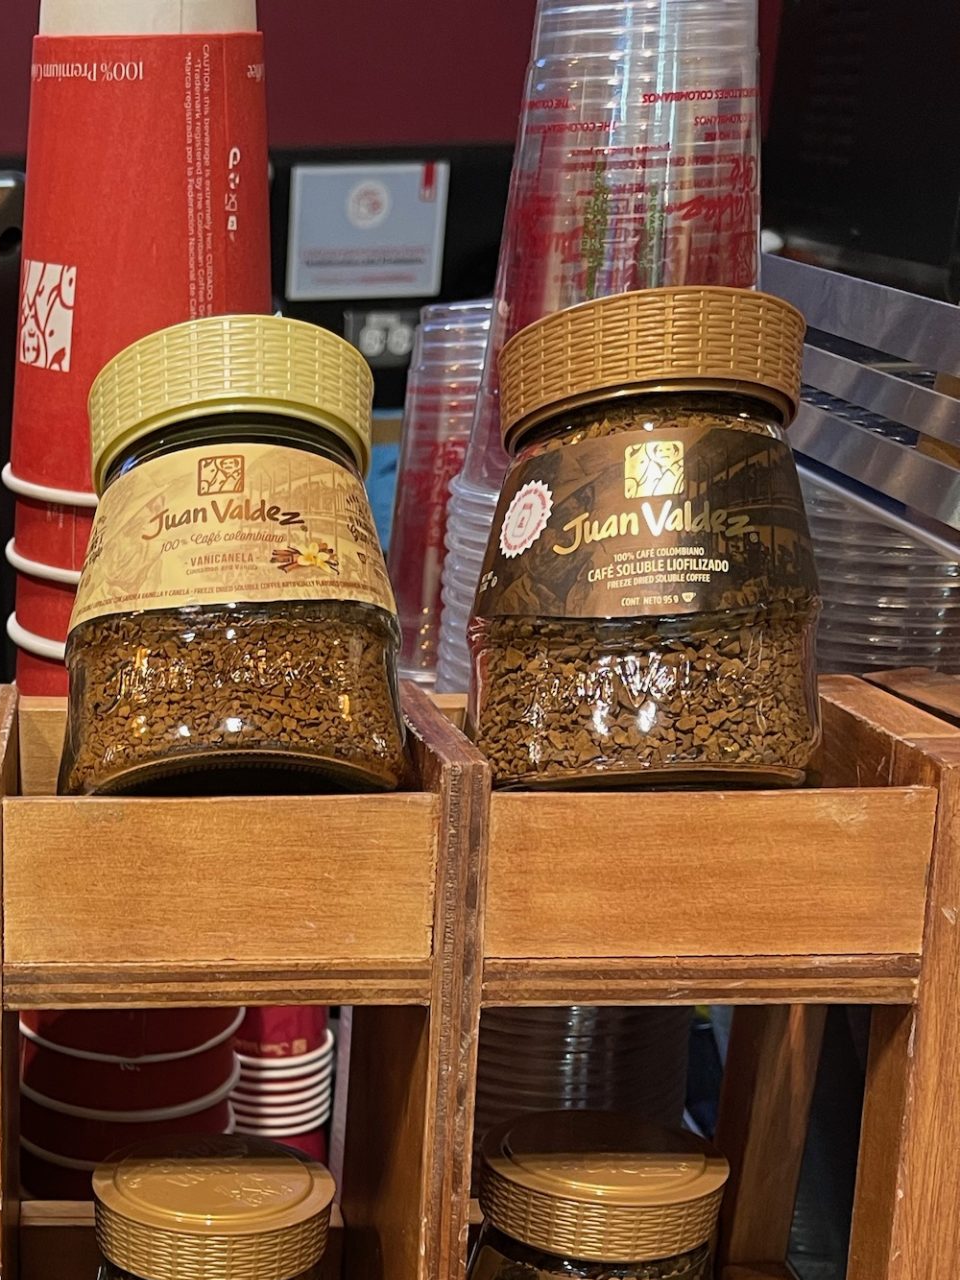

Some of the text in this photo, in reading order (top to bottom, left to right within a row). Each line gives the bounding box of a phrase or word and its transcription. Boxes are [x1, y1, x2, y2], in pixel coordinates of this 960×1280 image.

[43, 60, 143, 81] 100% Premium
[141, 499, 305, 540] Juan Valdez
[553, 511, 640, 556] Juan
[641, 500, 755, 537] Valdez
[191, 531, 221, 546] Café
[223, 530, 286, 544] colombiano
[191, 552, 254, 567] VANICANELA
[613, 547, 704, 563] 100% CAFÉ COLOMBIANO
[587, 558, 729, 583] CAFÉ SOLUBLE LIOFILIZADO
[607, 573, 710, 590] FREEZE DRIED SOLUBLE COFFEE
[643, 596, 662, 606] NETO
[663, 595, 673, 605] 95
